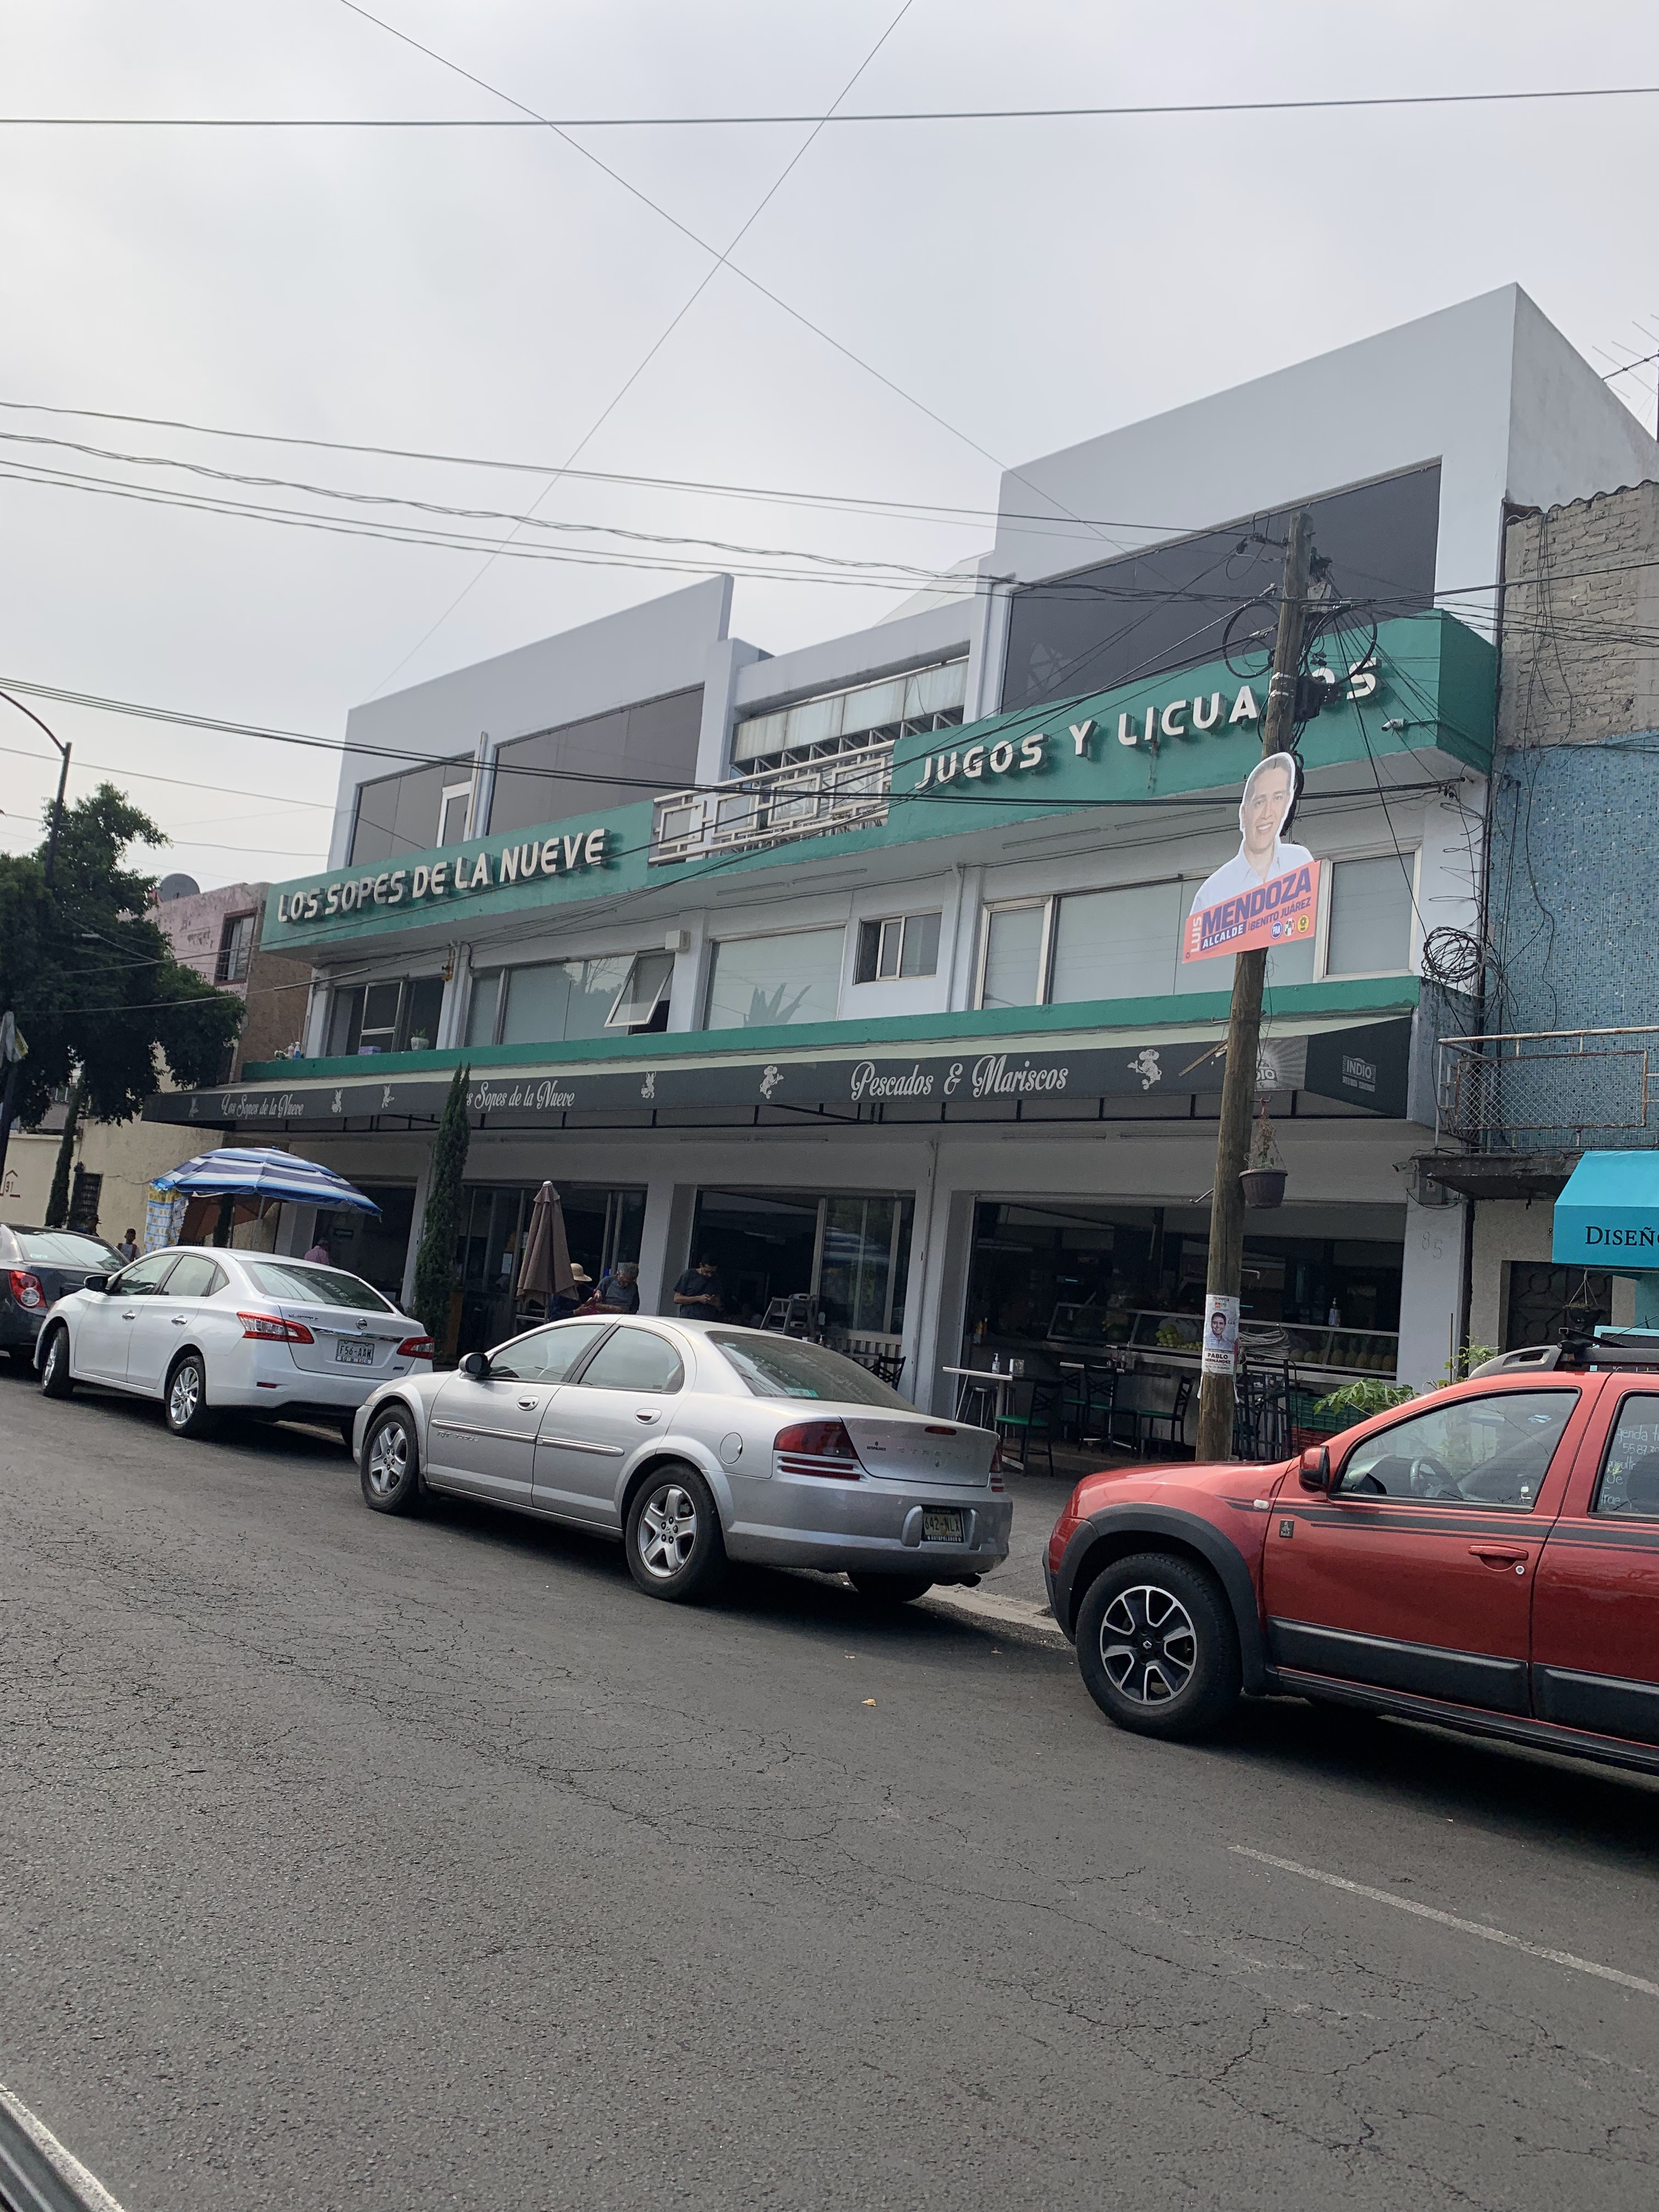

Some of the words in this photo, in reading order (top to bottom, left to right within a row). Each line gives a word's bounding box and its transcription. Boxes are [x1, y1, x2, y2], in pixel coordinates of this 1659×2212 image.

[916, 733, 1046, 790] JUGOS
[1069, 719, 1096, 757] Y
[1118, 657, 1379, 747] LICUAS
[277, 888, 321, 922] LOS
[325, 870, 408, 915] SOPES
[412, 861, 449, 898] DE
[454, 852, 493, 889] LA
[499, 828, 606, 883] NUEVE
[1201, 867, 1312, 938] MENDOZA
[1190, 916, 1202, 953] LUIS
[1202, 923, 1244, 950] ALCALDE
[1250, 910, 1279, 931] BENITO
[1280, 896, 1311, 919] JUÁREZ
[1272, 926, 1281, 935] PAN
[851, 1060, 934, 1101] Pescados
[943, 1063, 963, 1095] &
[972, 1054, 1069, 1098] Mariscos
[1346, 1059, 1372, 1080] INDIO
[222, 1093, 236, 1116] Los
[236, 1094, 258, 1119] Sopes
[259, 1097, 269, 1115] de
[269, 1097, 278, 1116] la
[278, 1093, 304, 1118] Nueve
[474, 1081, 507, 1112] Sopes
[508, 1085, 522, 1107] de
[523, 1085, 533, 1107] la
[537, 1080, 575, 1110] Nueve
[1585, 1226, 1659, 1247] DISEÑ
